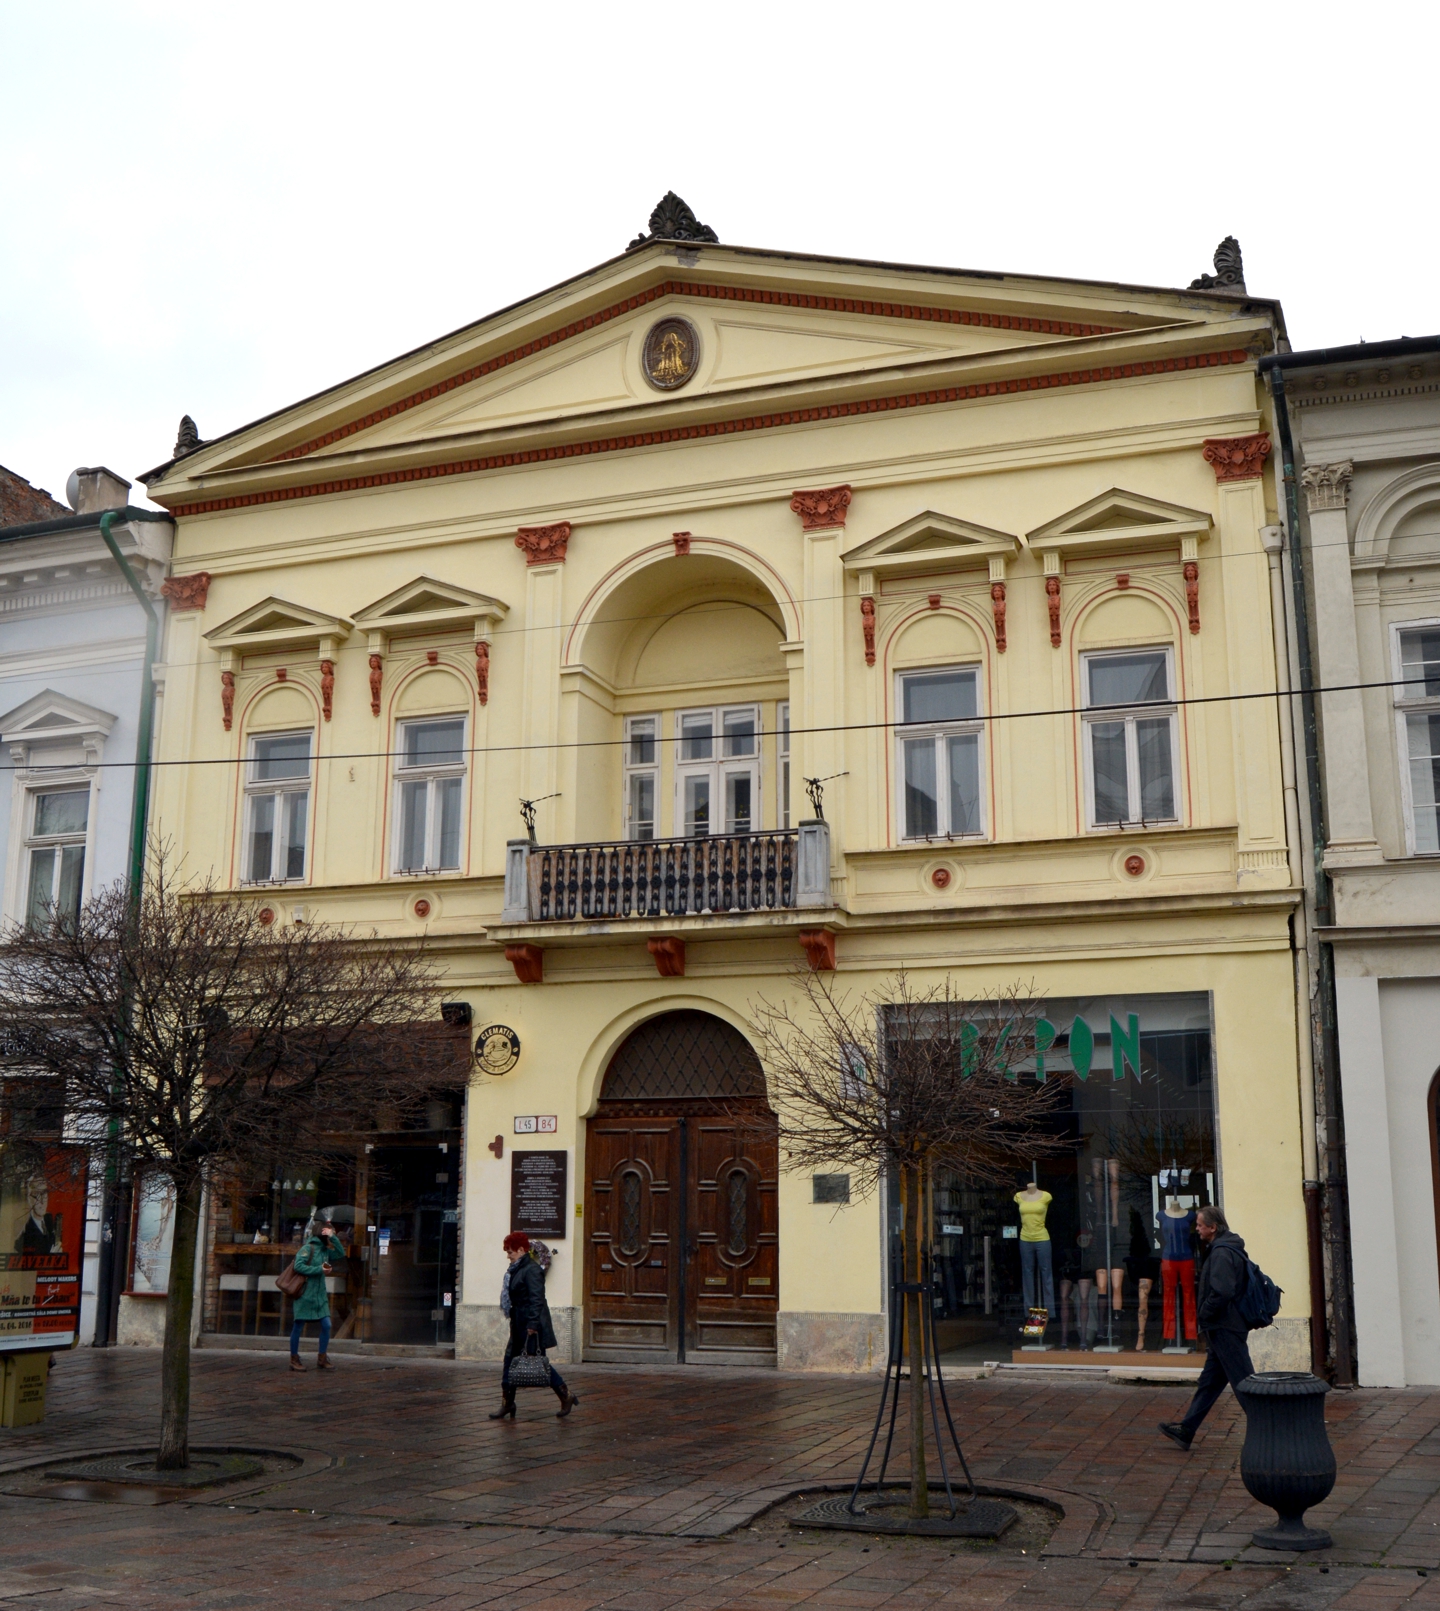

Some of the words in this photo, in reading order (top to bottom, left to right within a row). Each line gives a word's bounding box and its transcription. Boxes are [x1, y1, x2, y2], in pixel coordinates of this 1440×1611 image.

[480, 1026, 514, 1040] CLEMATIS
[541, 1118, 552, 1129] 84
[8, 1255, 67, 1269] HAVELKA
